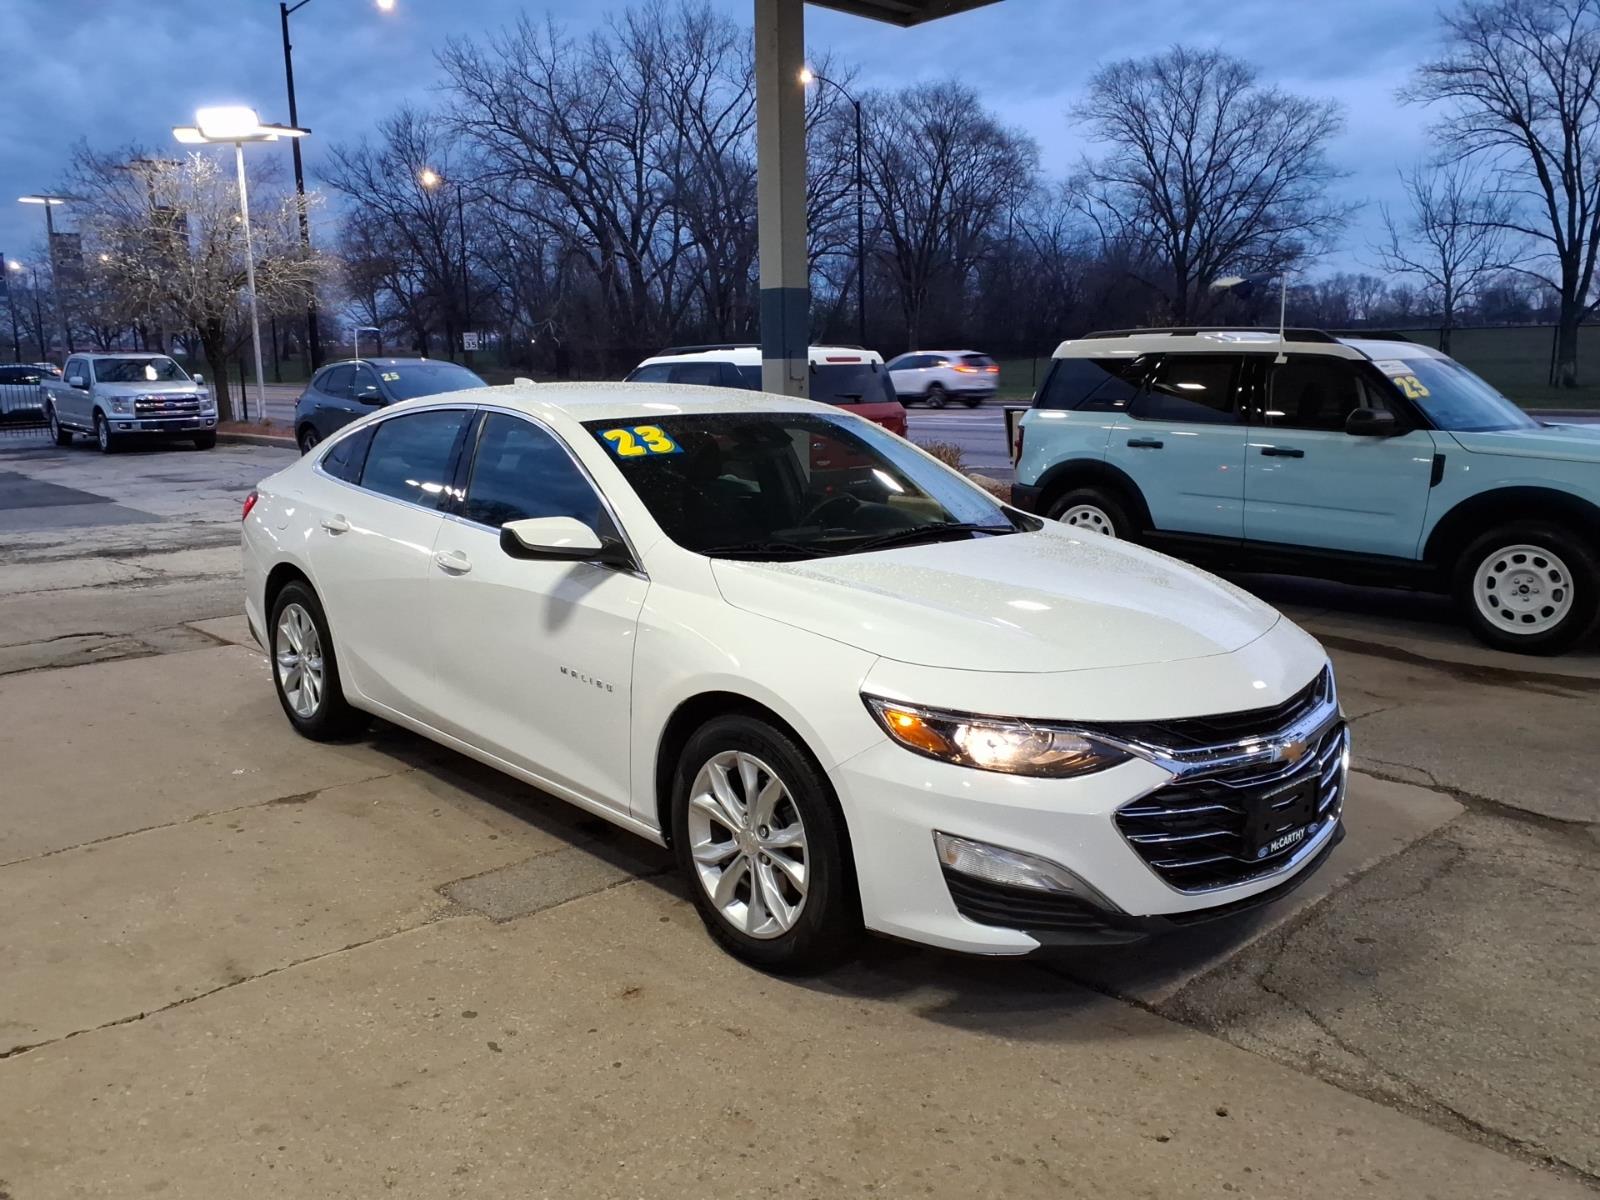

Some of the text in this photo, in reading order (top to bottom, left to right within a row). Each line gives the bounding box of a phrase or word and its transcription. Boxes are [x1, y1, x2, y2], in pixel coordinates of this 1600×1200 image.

[465, 341, 477, 349] 35
[1393, 375, 1430, 399] 23
[602, 425, 675, 457] 23
[560, 665, 613, 693] MALIBU
[1270, 827, 1306, 853] McCARTHY
